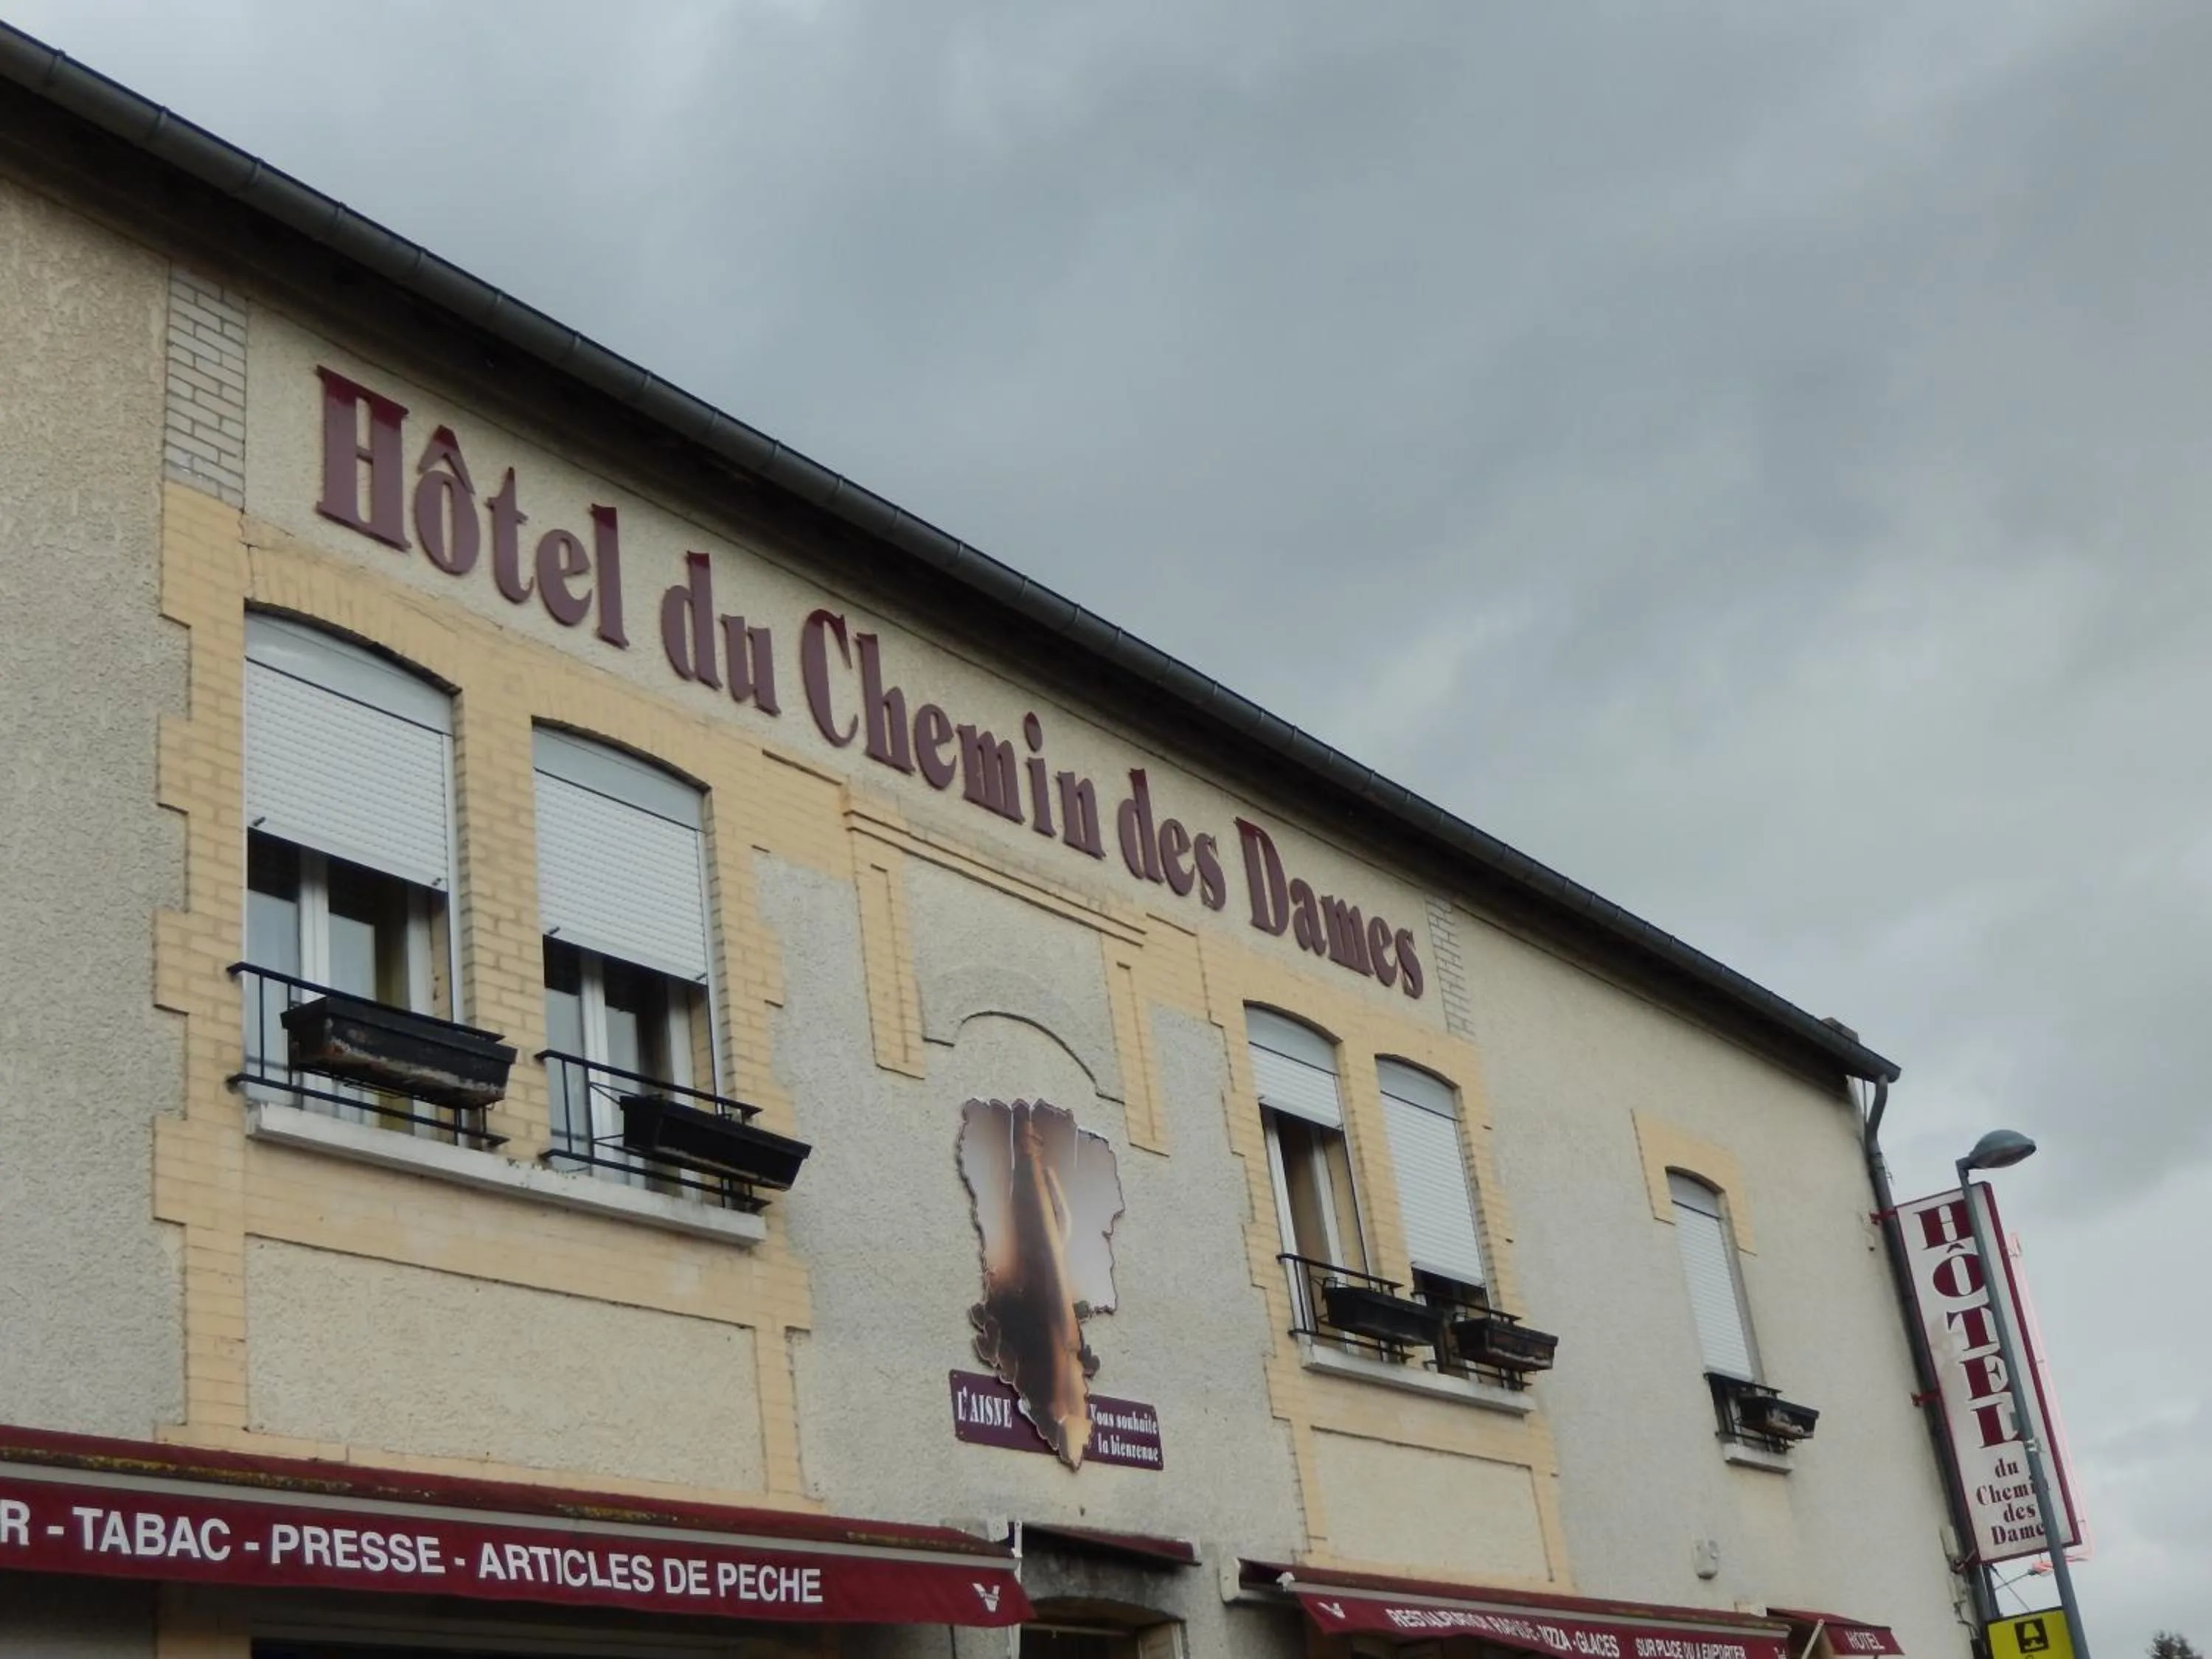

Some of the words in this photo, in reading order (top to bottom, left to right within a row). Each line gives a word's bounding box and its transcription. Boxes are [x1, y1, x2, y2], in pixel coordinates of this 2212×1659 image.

[316, 364, 630, 650] Hôtel
[661, 550, 782, 717] du
[801, 608, 1106, 860] Chemin
[1118, 768, 1227, 911] des
[1235, 816, 1425, 999] Dames
[1116, 1411, 1158, 1435] souhaite
[1098, 1432, 1109, 1454] la
[1994, 1458, 2020, 1478] du
[1976, 1475, 2037, 1506] Chemi
[2003, 1503, 2036, 1523] des
[1992, 1523, 2045, 1545] Dame
[72, 1506, 231, 1561] TABAC
[271, 1524, 445, 1573] PRESSE
[479, 1543, 655, 1593] ARTICLES
[665, 1558, 711, 1596] DE
[718, 1563, 824, 1604] PECHE
[1574, 1630, 1620, 1658] GLACES
